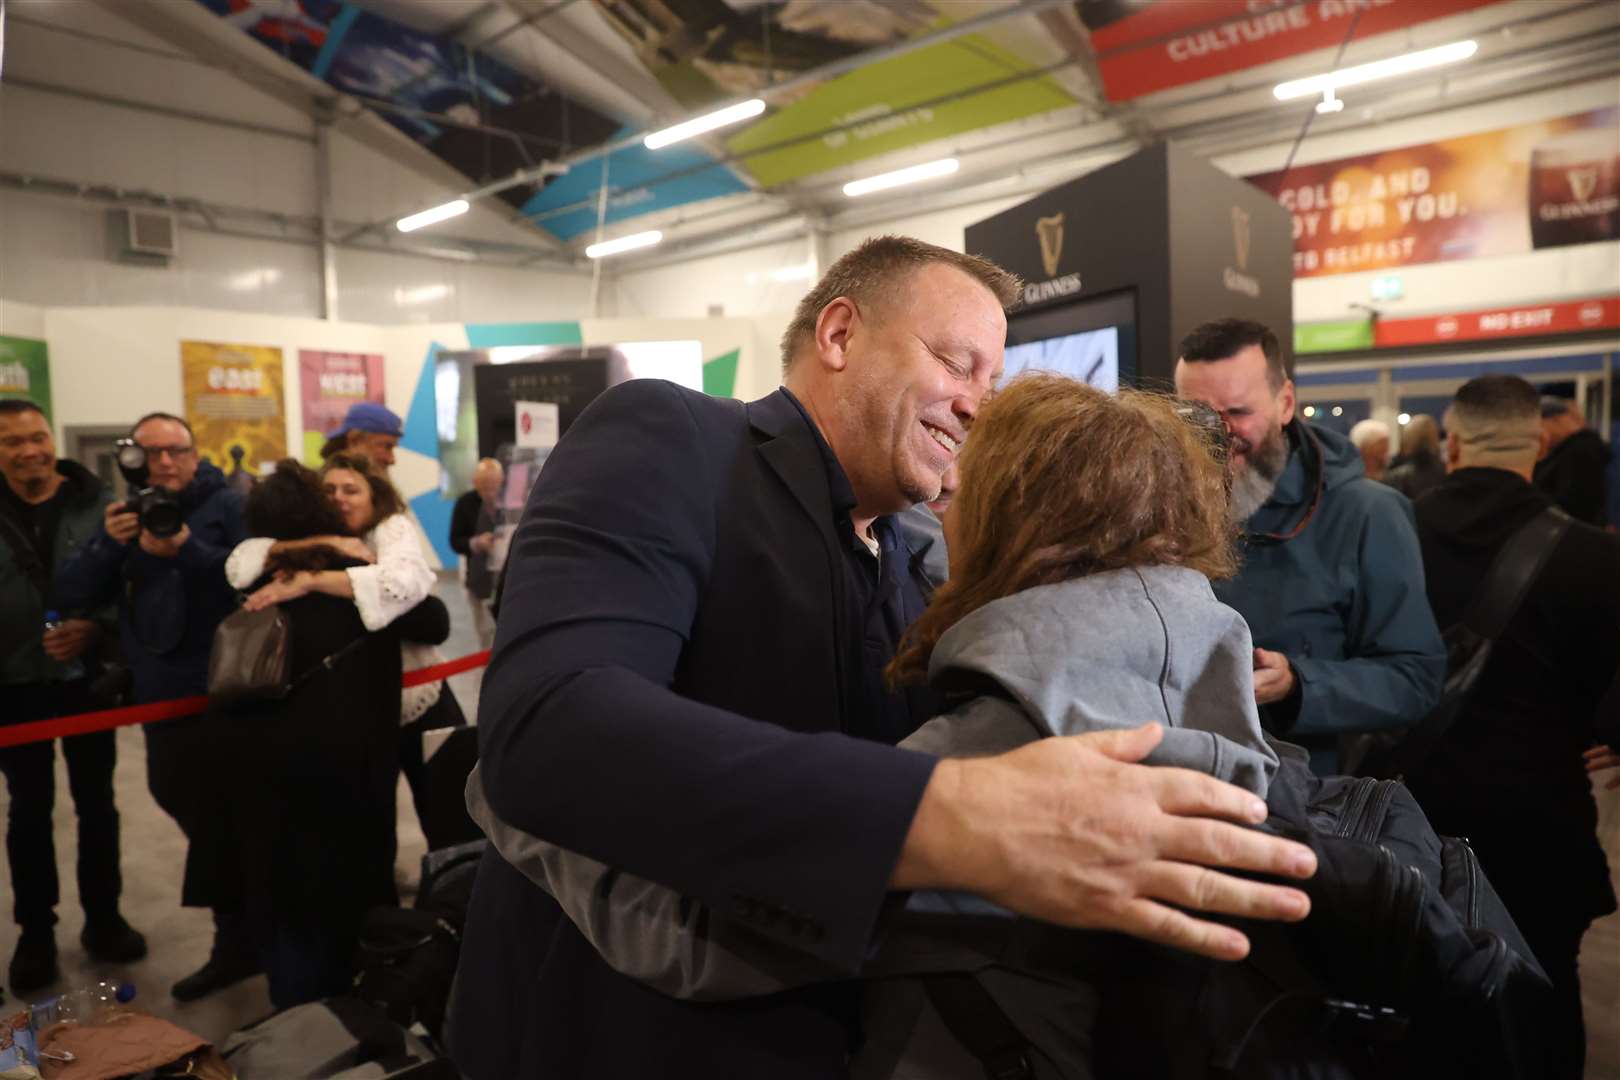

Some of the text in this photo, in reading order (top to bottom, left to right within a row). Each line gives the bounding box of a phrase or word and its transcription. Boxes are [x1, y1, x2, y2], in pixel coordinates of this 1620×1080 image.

[1167, 6, 1311, 61] CULTURE
[1370, 167, 1431, 199] AND
[1330, 202, 1386, 234] FOR
[1397, 191, 1468, 224] YOU.
[1324, 236, 1416, 268] BELFAST
[1478, 313, 1509, 332] NO
[1510, 308, 1554, 330] EXIT
[208, 366, 263, 390] east
[319, 373, 367, 394] west
